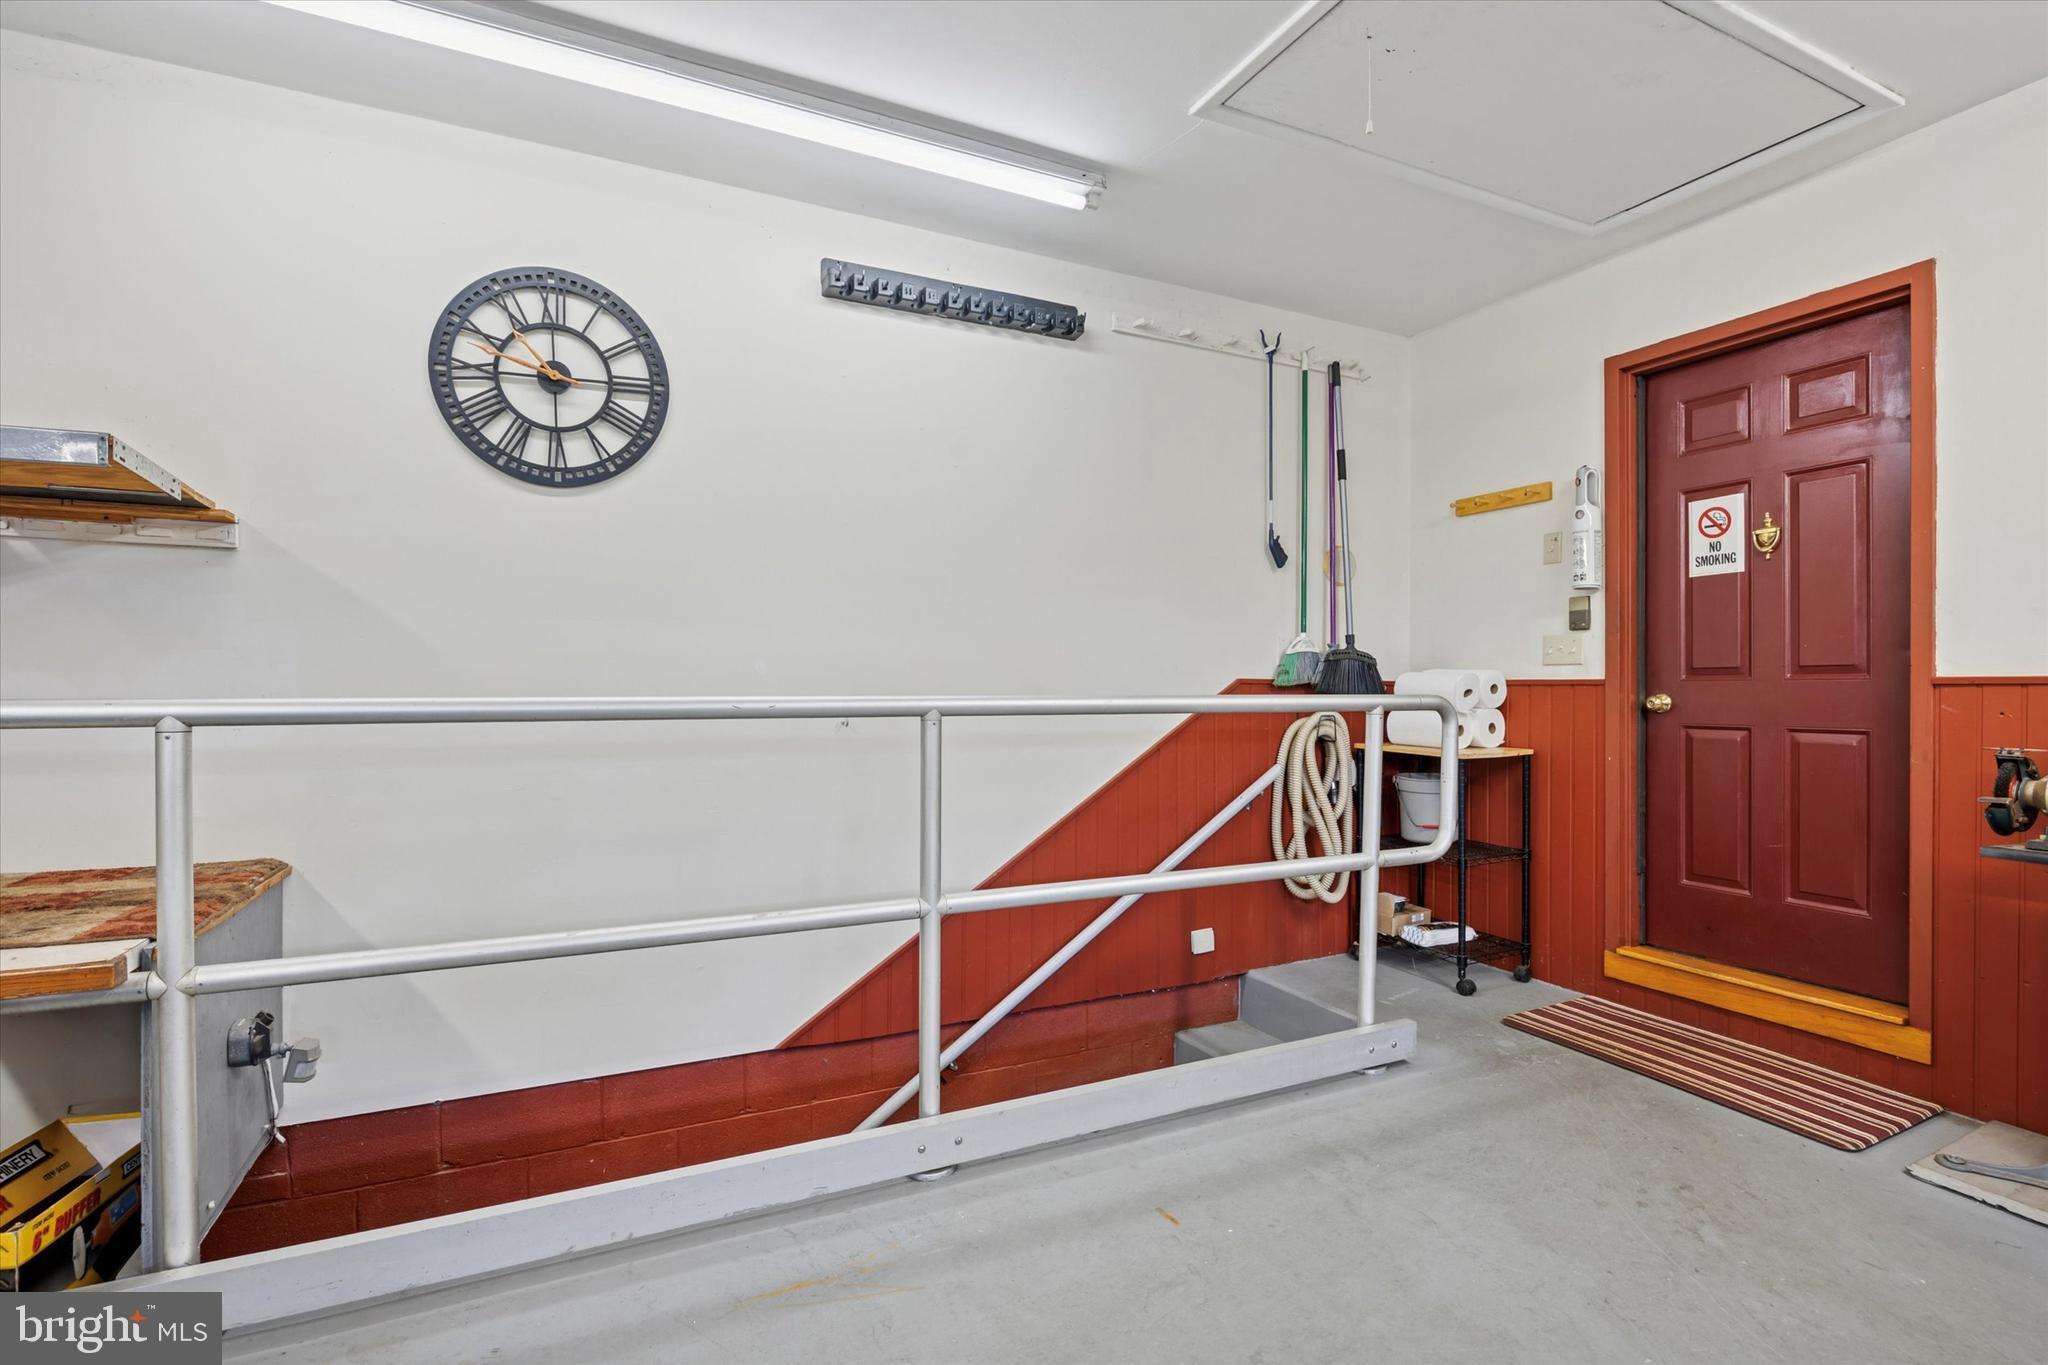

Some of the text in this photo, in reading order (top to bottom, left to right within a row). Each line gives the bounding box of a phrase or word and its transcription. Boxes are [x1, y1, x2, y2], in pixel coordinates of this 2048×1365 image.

[1709, 541, 1722, 553] NO
[1695, 552, 1737, 567] SMOKING
[54, 1186, 101, 1238] BUFFER
